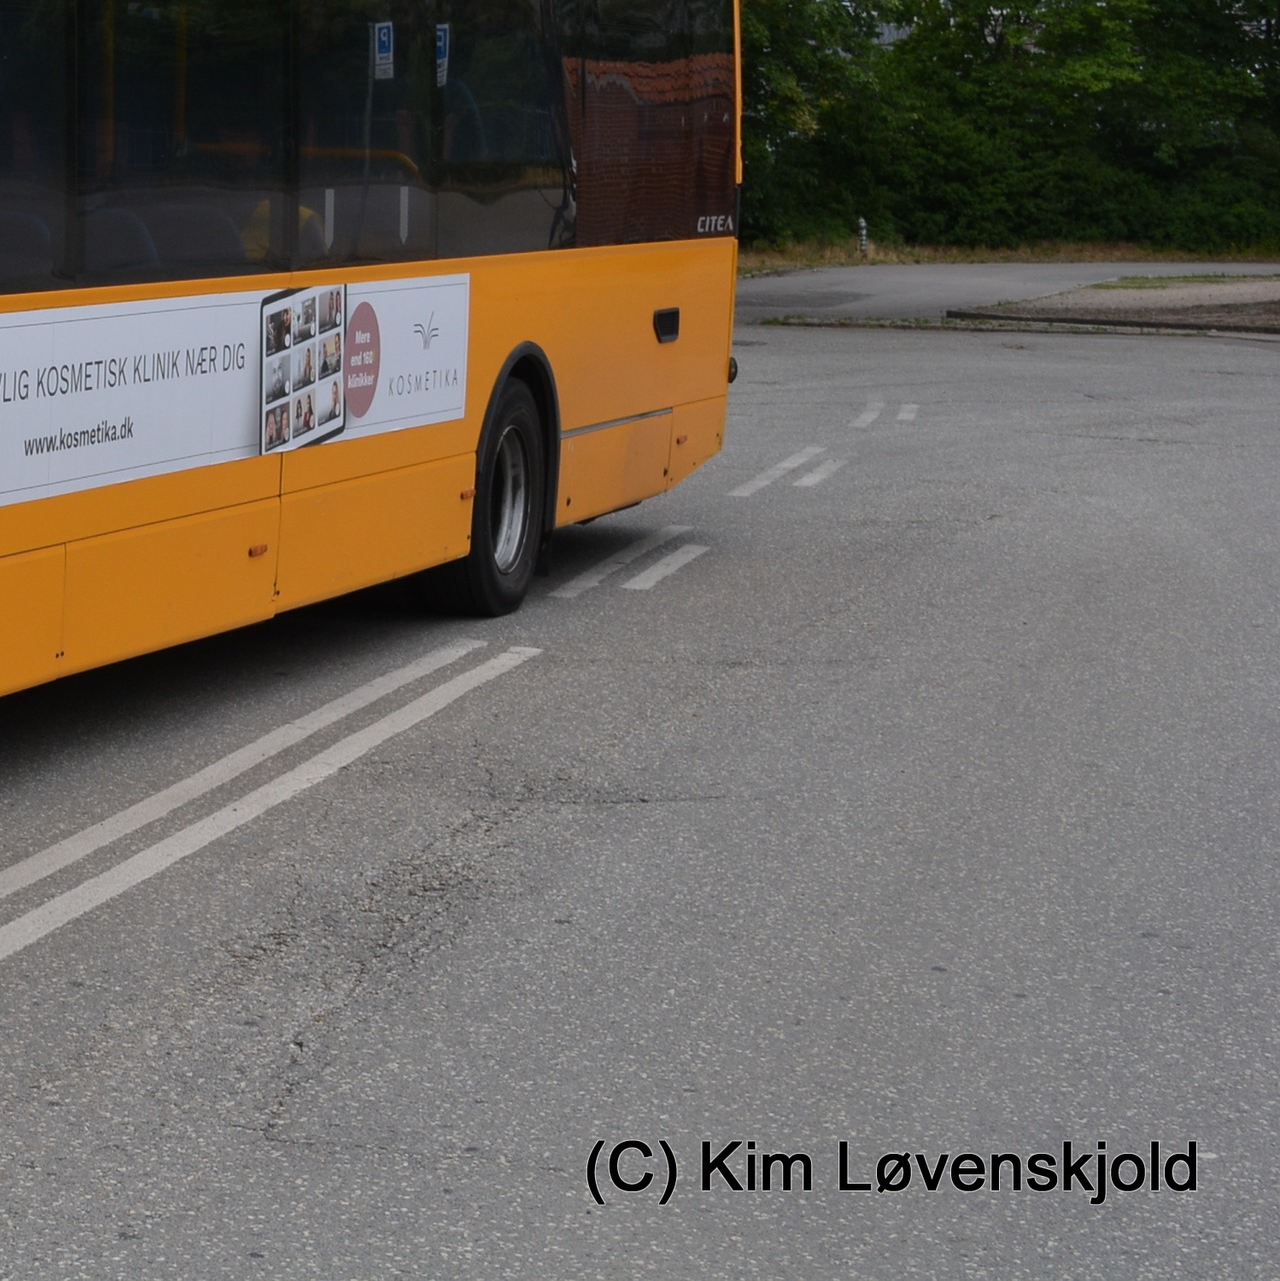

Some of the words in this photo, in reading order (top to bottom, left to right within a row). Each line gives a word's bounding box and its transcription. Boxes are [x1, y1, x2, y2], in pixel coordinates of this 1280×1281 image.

[697, 215, 734, 233] CITEA
[355, 331, 371, 344] Mere
[351, 351, 362, 366] end
[36, 357, 128, 398] KOSMETISK
[133, 350, 181, 384] KLINIK
[185, 346, 218, 376] NÆR
[222, 343, 246, 371] DIG
[348, 374, 375, 389] klinikker
[388, 369, 458, 397] KOSMETIKA
[24, 416, 135, 456] www.kosmetika.dk
